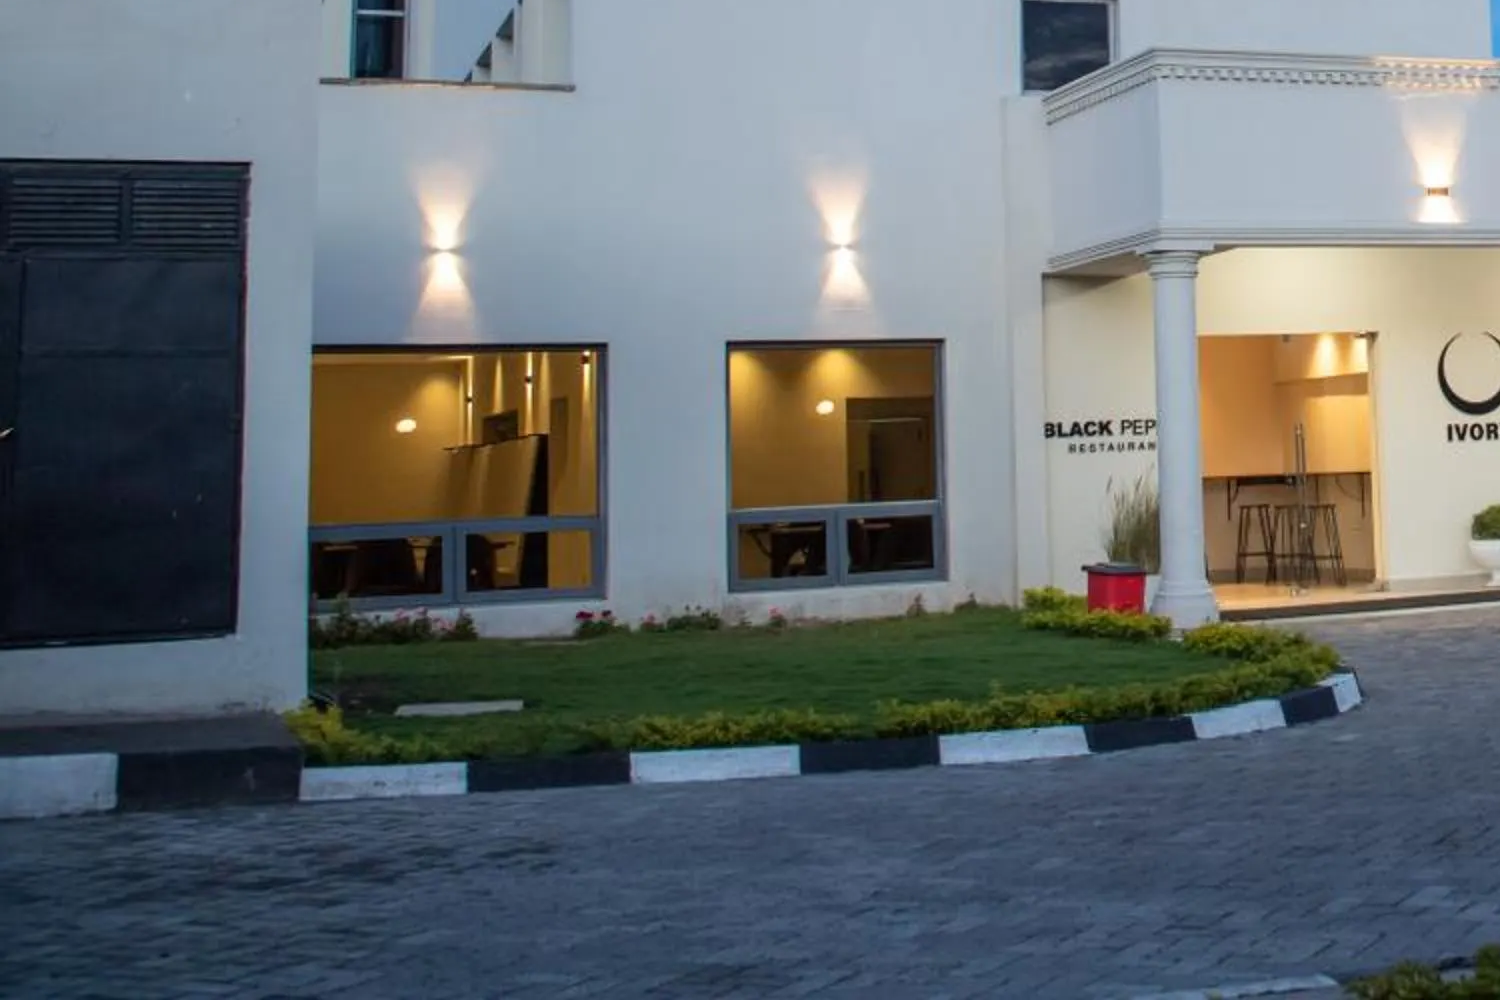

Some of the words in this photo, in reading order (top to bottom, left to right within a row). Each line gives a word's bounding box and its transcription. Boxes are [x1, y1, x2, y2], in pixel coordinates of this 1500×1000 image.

[1044, 421, 1113, 438] BLACK
[1120, 420, 1156, 436] PEP
[1068, 442, 1156, 453] RESTAURAN
